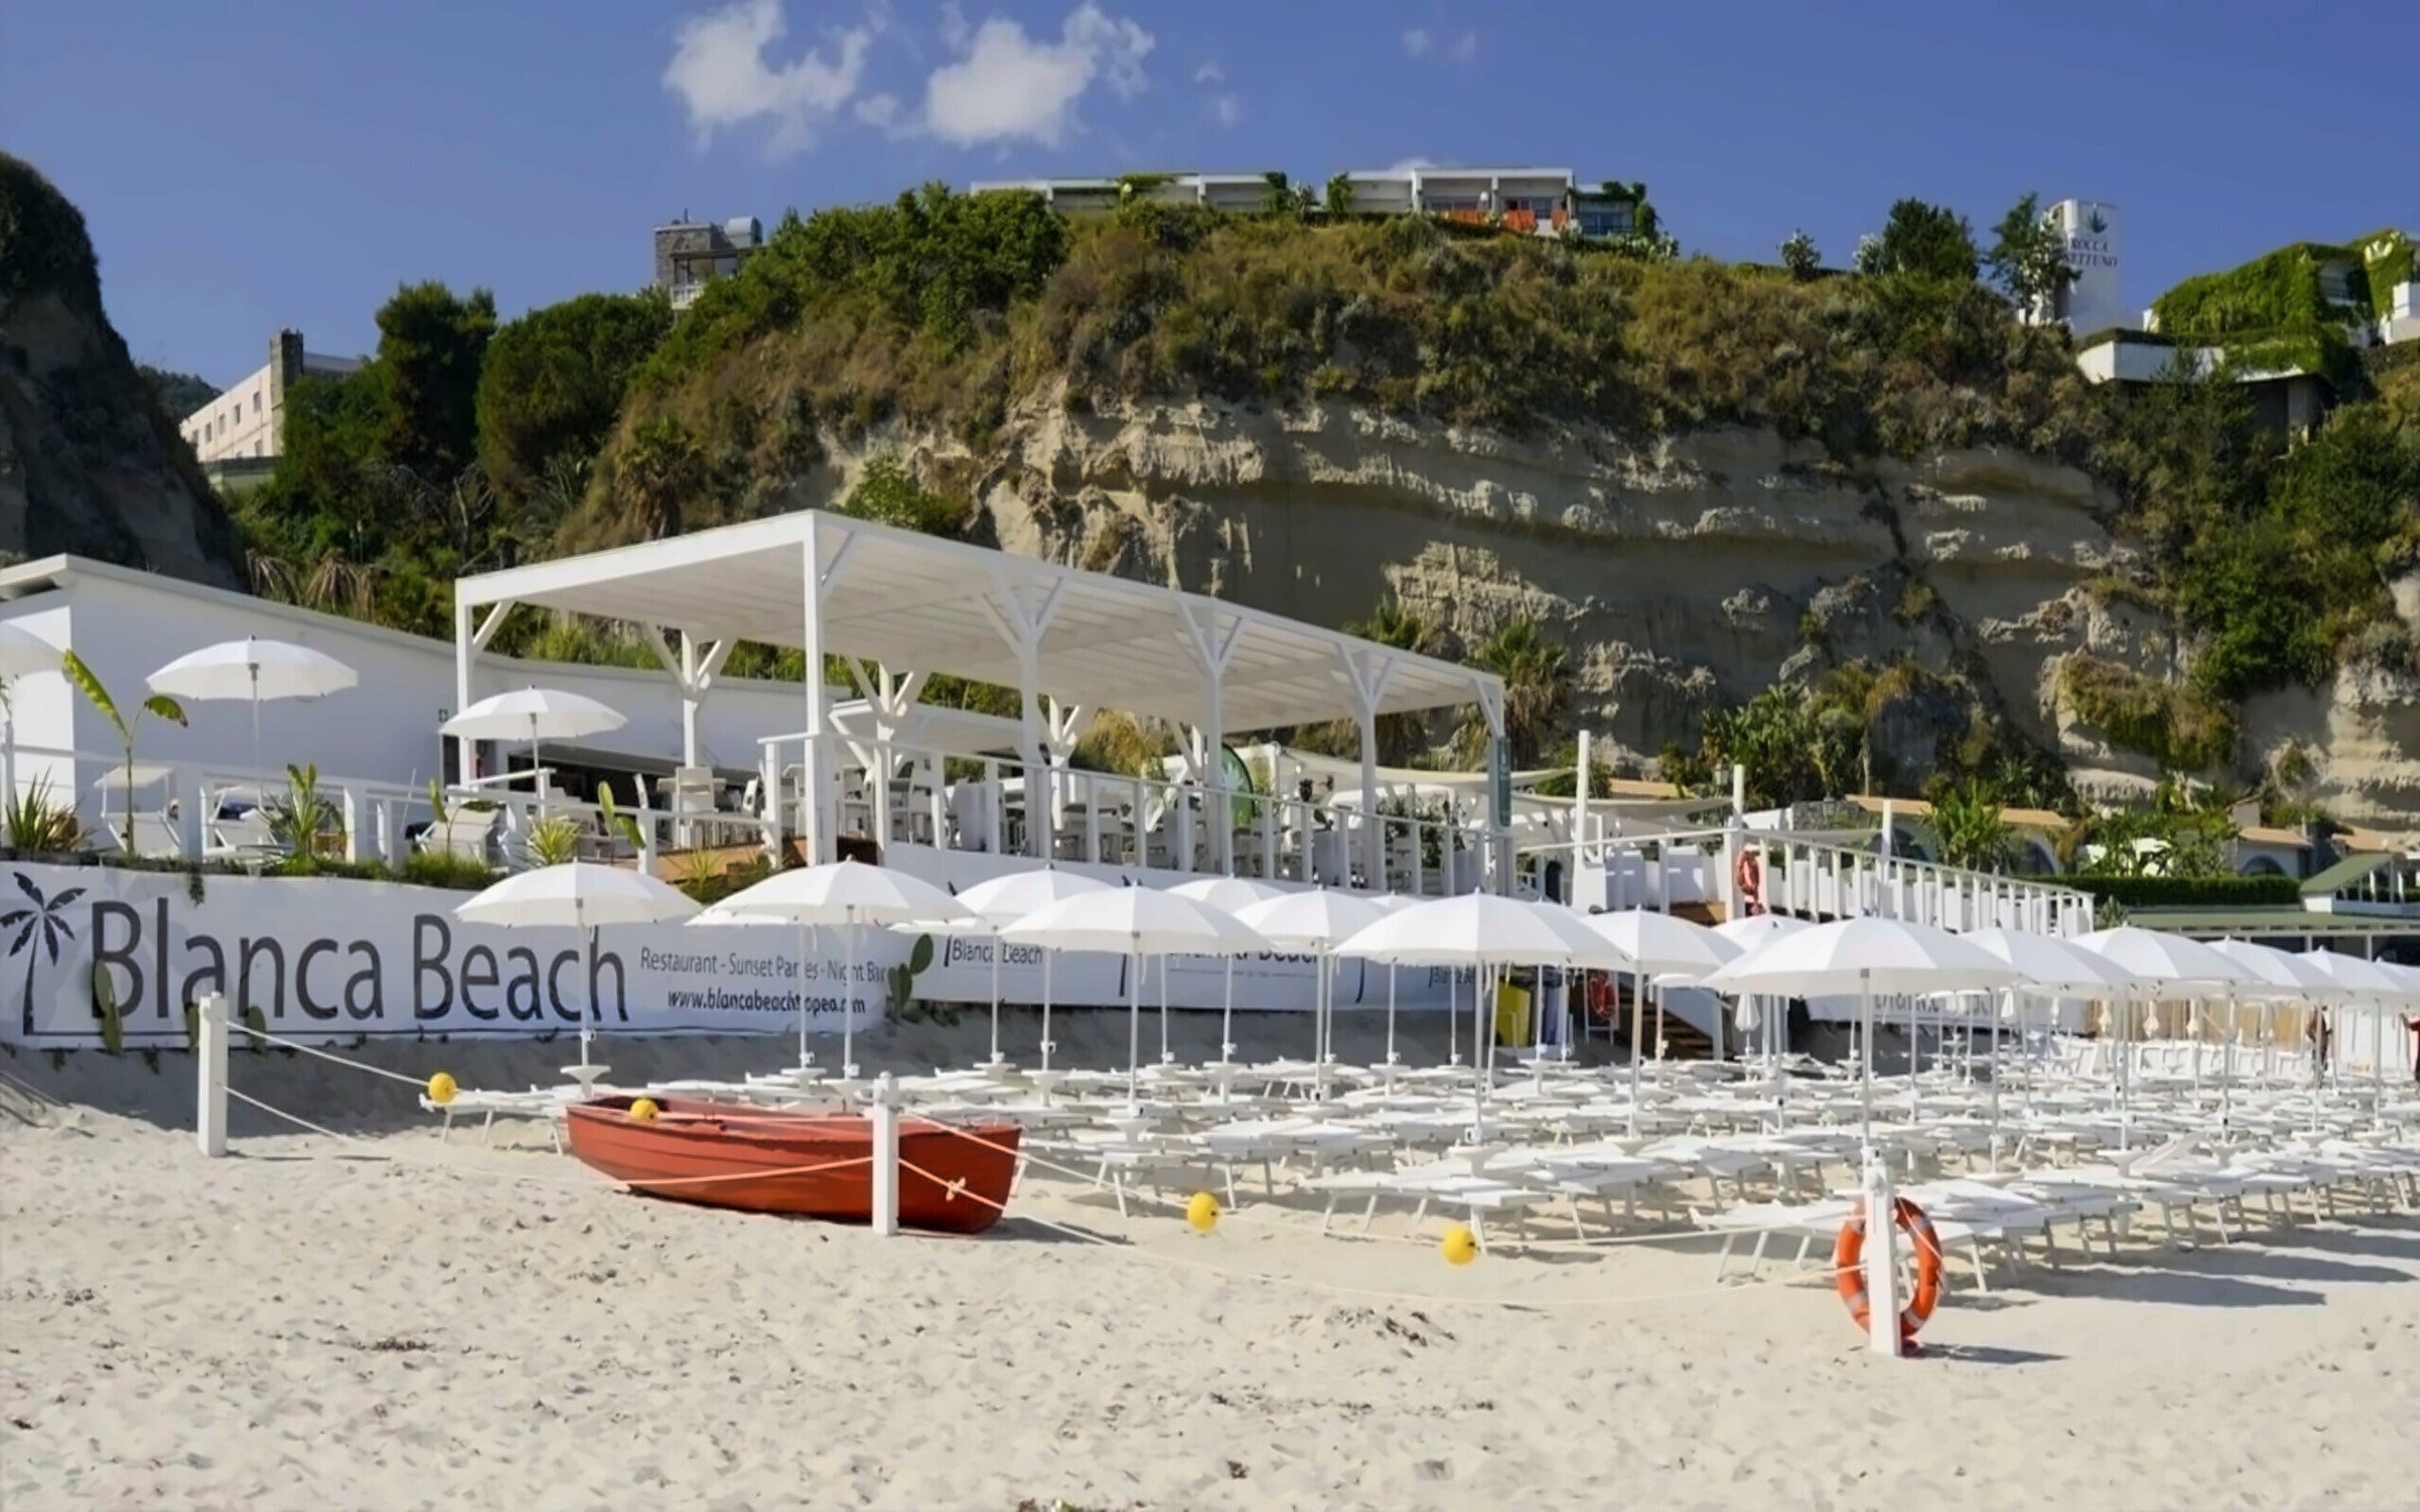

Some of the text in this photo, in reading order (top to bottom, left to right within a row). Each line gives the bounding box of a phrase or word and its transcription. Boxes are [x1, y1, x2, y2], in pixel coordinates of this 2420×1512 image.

[92, 897, 629, 1022] Blanca Beach
[641, 946, 717, 974] Restaurant
[728, 953, 773, 977] Sunset
[775, 954, 819, 980] Pares
[667, 988, 866, 1017] www.blancabeachtopea.cm
